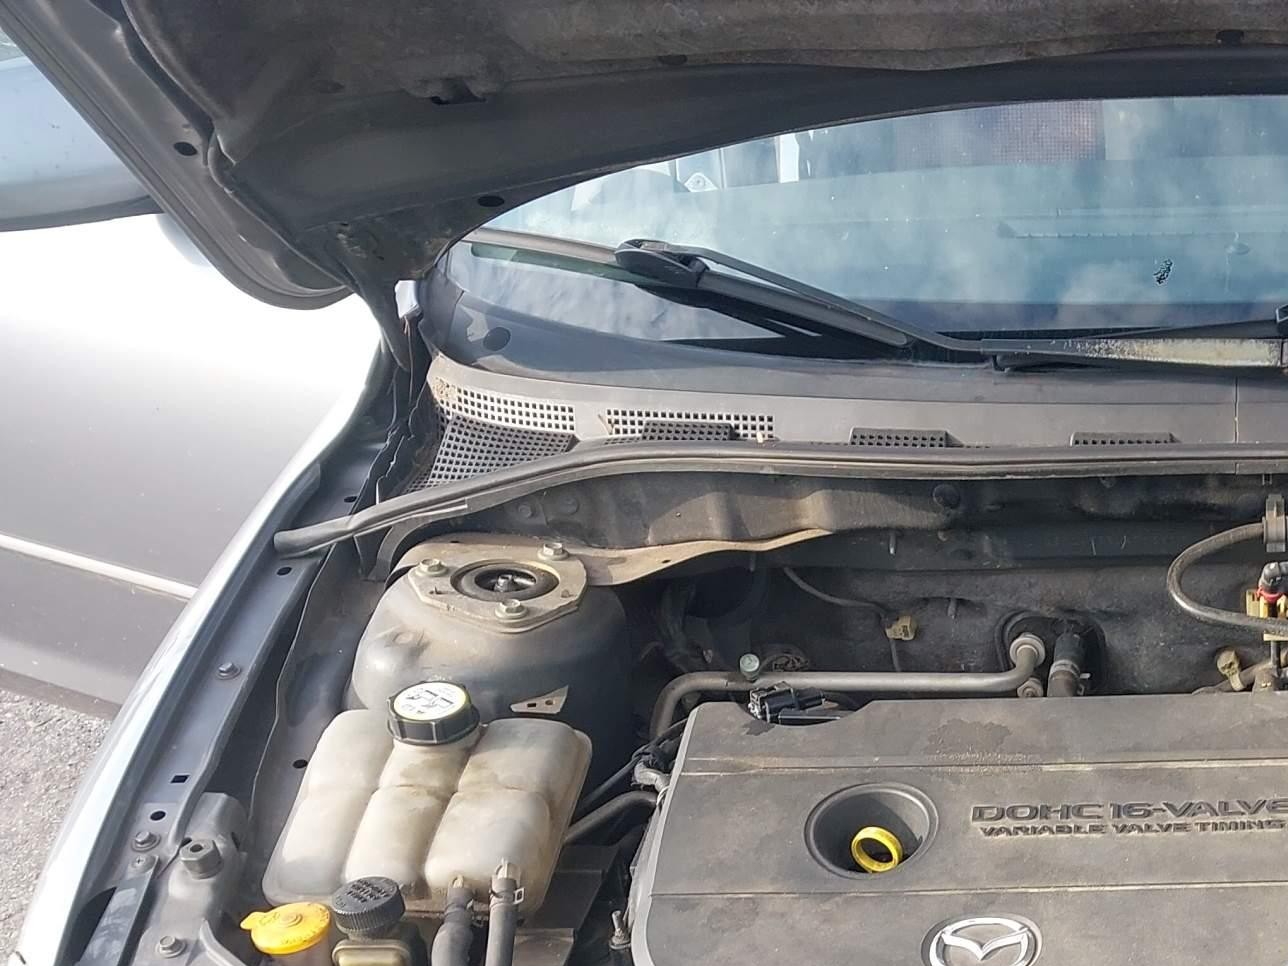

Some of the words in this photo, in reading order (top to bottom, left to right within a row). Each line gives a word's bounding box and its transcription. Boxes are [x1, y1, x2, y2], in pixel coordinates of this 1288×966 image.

[971, 803, 1104, 822] DOHC
[979, 823, 1106, 837] VARIABLE
[1111, 822, 1192, 835] VALVE
[1194, 819, 1287, 833] TIMING
